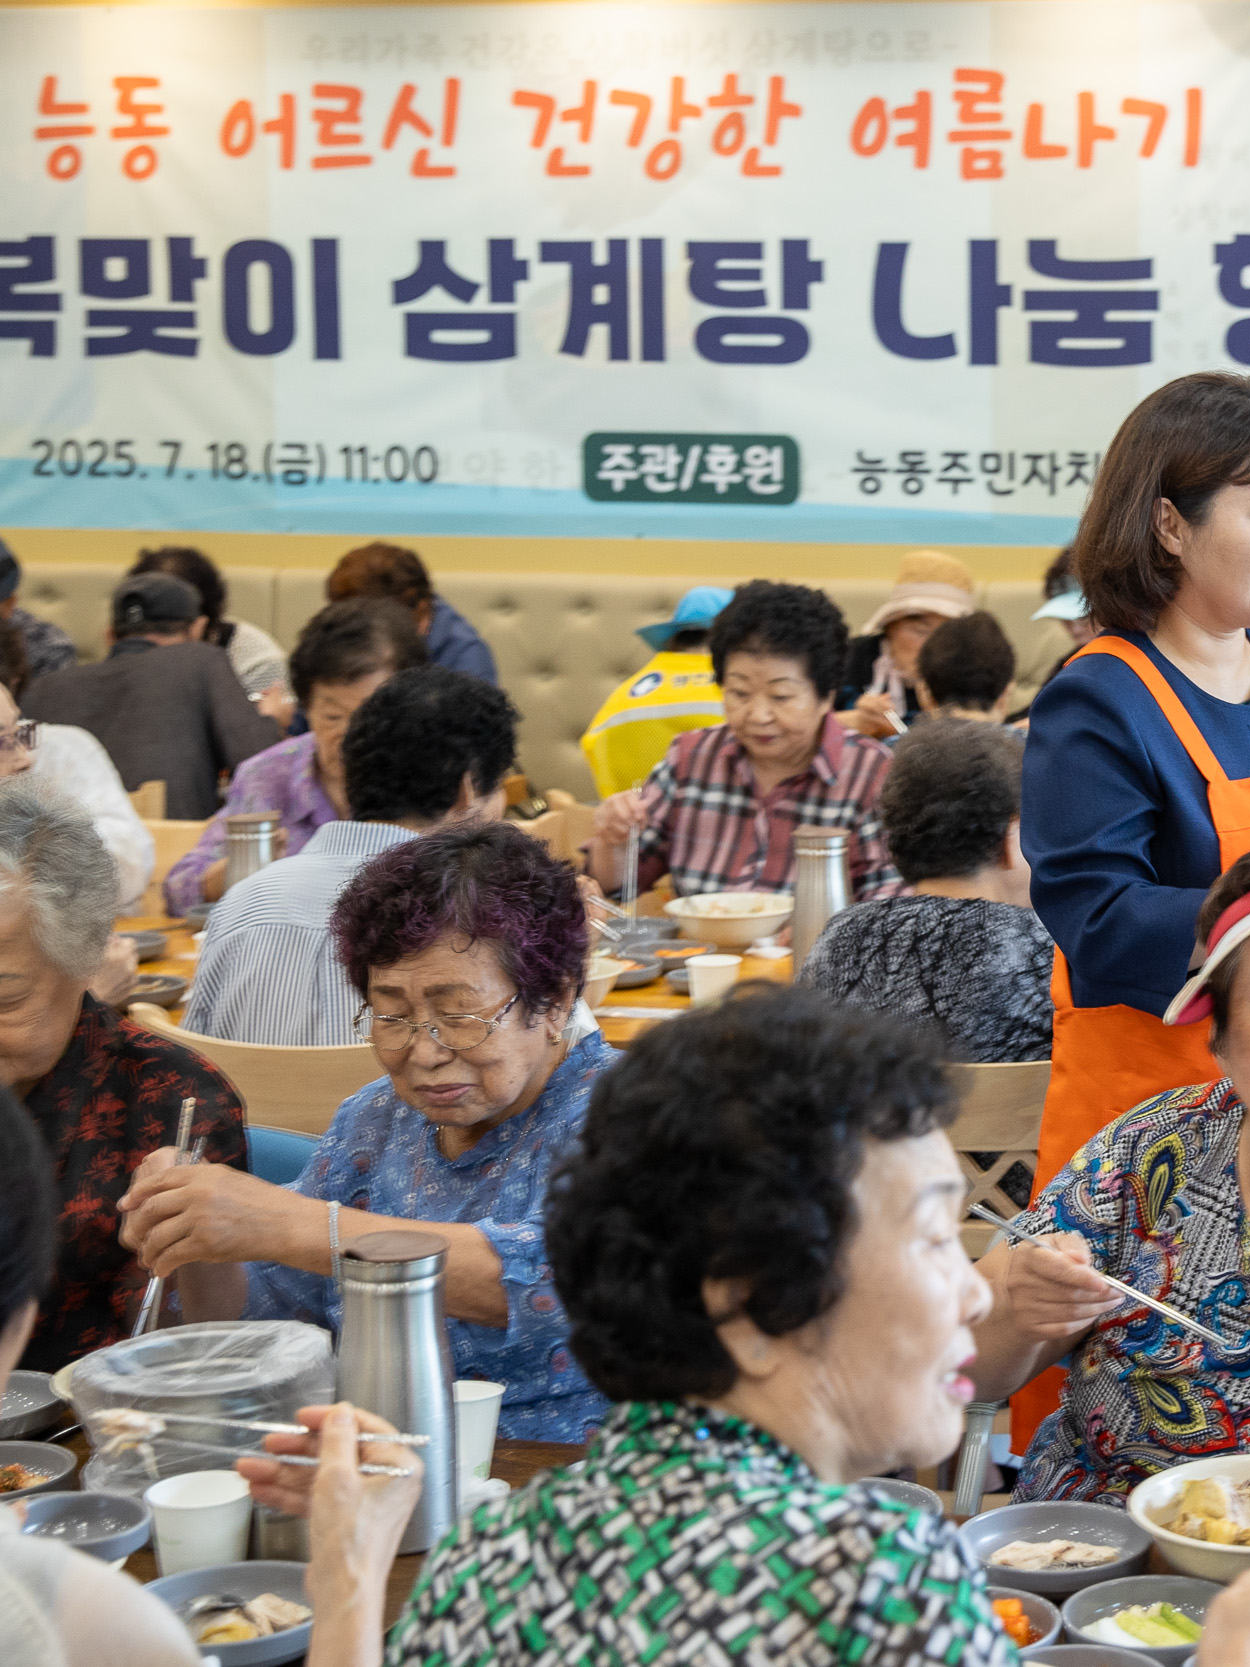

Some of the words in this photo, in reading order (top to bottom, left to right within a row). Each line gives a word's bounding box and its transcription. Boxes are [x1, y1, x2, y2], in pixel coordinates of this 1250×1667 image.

[33, 75, 172, 182] 능동
[218, 76, 462, 179] 어르신
[511, 72, 803, 182] 건강한
[849, 67, 1203, 182] 여름나기
[392, 238, 825, 366] 삼계탕
[872, 239, 1161, 368] 나눔
[33, 439, 148, 478] 2025.
[161, 441, 194, 479] 7.
[207, 442, 326, 487] 18.(금)
[340, 444, 440, 485] 11:00
[597, 445, 785, 494] 주관/후원
[851, 449, 1102, 499] 능동주민자치
